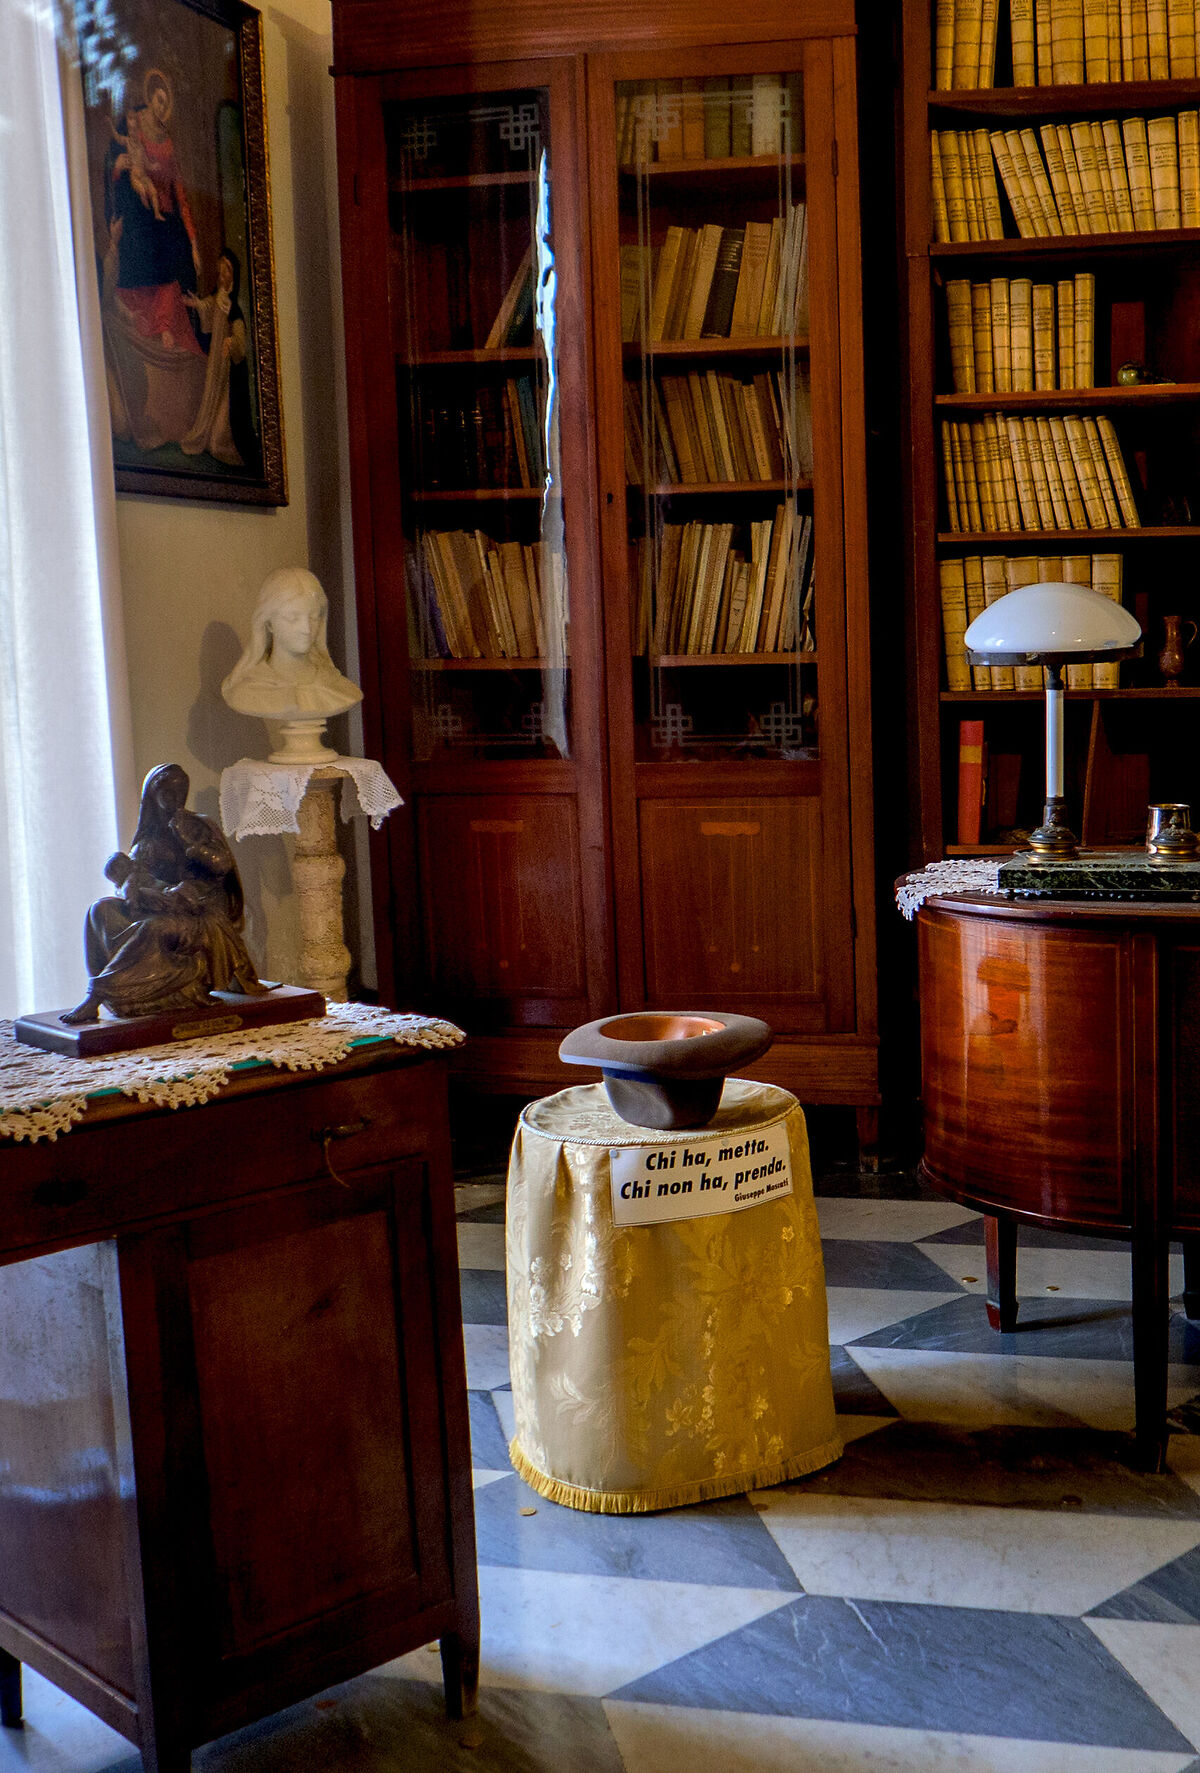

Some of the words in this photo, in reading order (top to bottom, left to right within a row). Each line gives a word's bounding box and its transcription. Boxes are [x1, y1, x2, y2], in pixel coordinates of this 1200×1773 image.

[646, 1150, 676, 1171] Chi
[682, 1149, 712, 1167] ha,
[718, 1139, 769, 1161] metta.
[620, 1179, 652, 1200] Chi
[656, 1179, 693, 1197] non
[700, 1172, 729, 1191] ha,
[734, 1157, 786, 1189] prenda.
[734, 1186, 765, 1202] Giuseppe
[765, 1177, 789, 1193] Moscati
